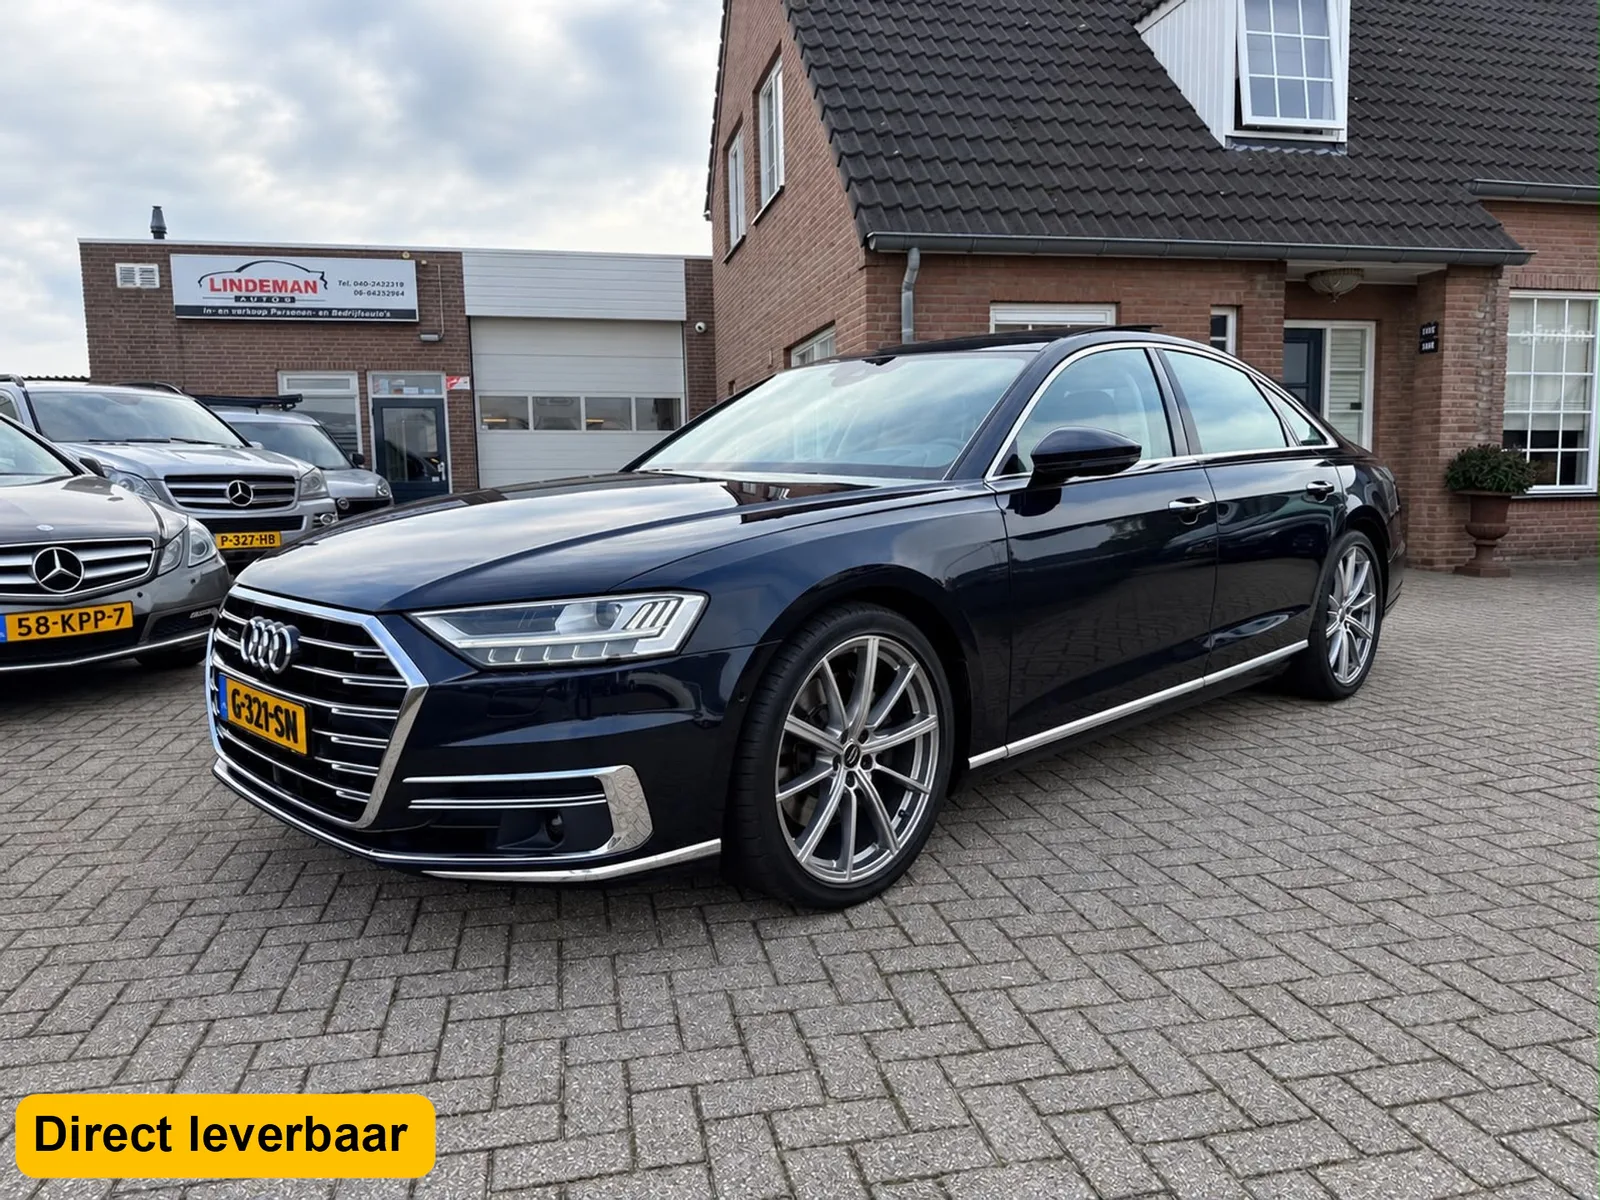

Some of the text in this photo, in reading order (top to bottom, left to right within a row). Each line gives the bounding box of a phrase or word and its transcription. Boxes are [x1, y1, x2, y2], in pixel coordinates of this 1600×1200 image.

[209, 277, 318, 294] LINDEMAN
[231, 308, 268, 317] verkoop
[318, 309, 329, 317] en
[331, 309, 391, 319] Bedrijfsauto's
[220, 533, 276, 547] P-327-HB
[17, 607, 125, 637] 58-KPP-7
[231, 687, 299, 745] G-321-SN
